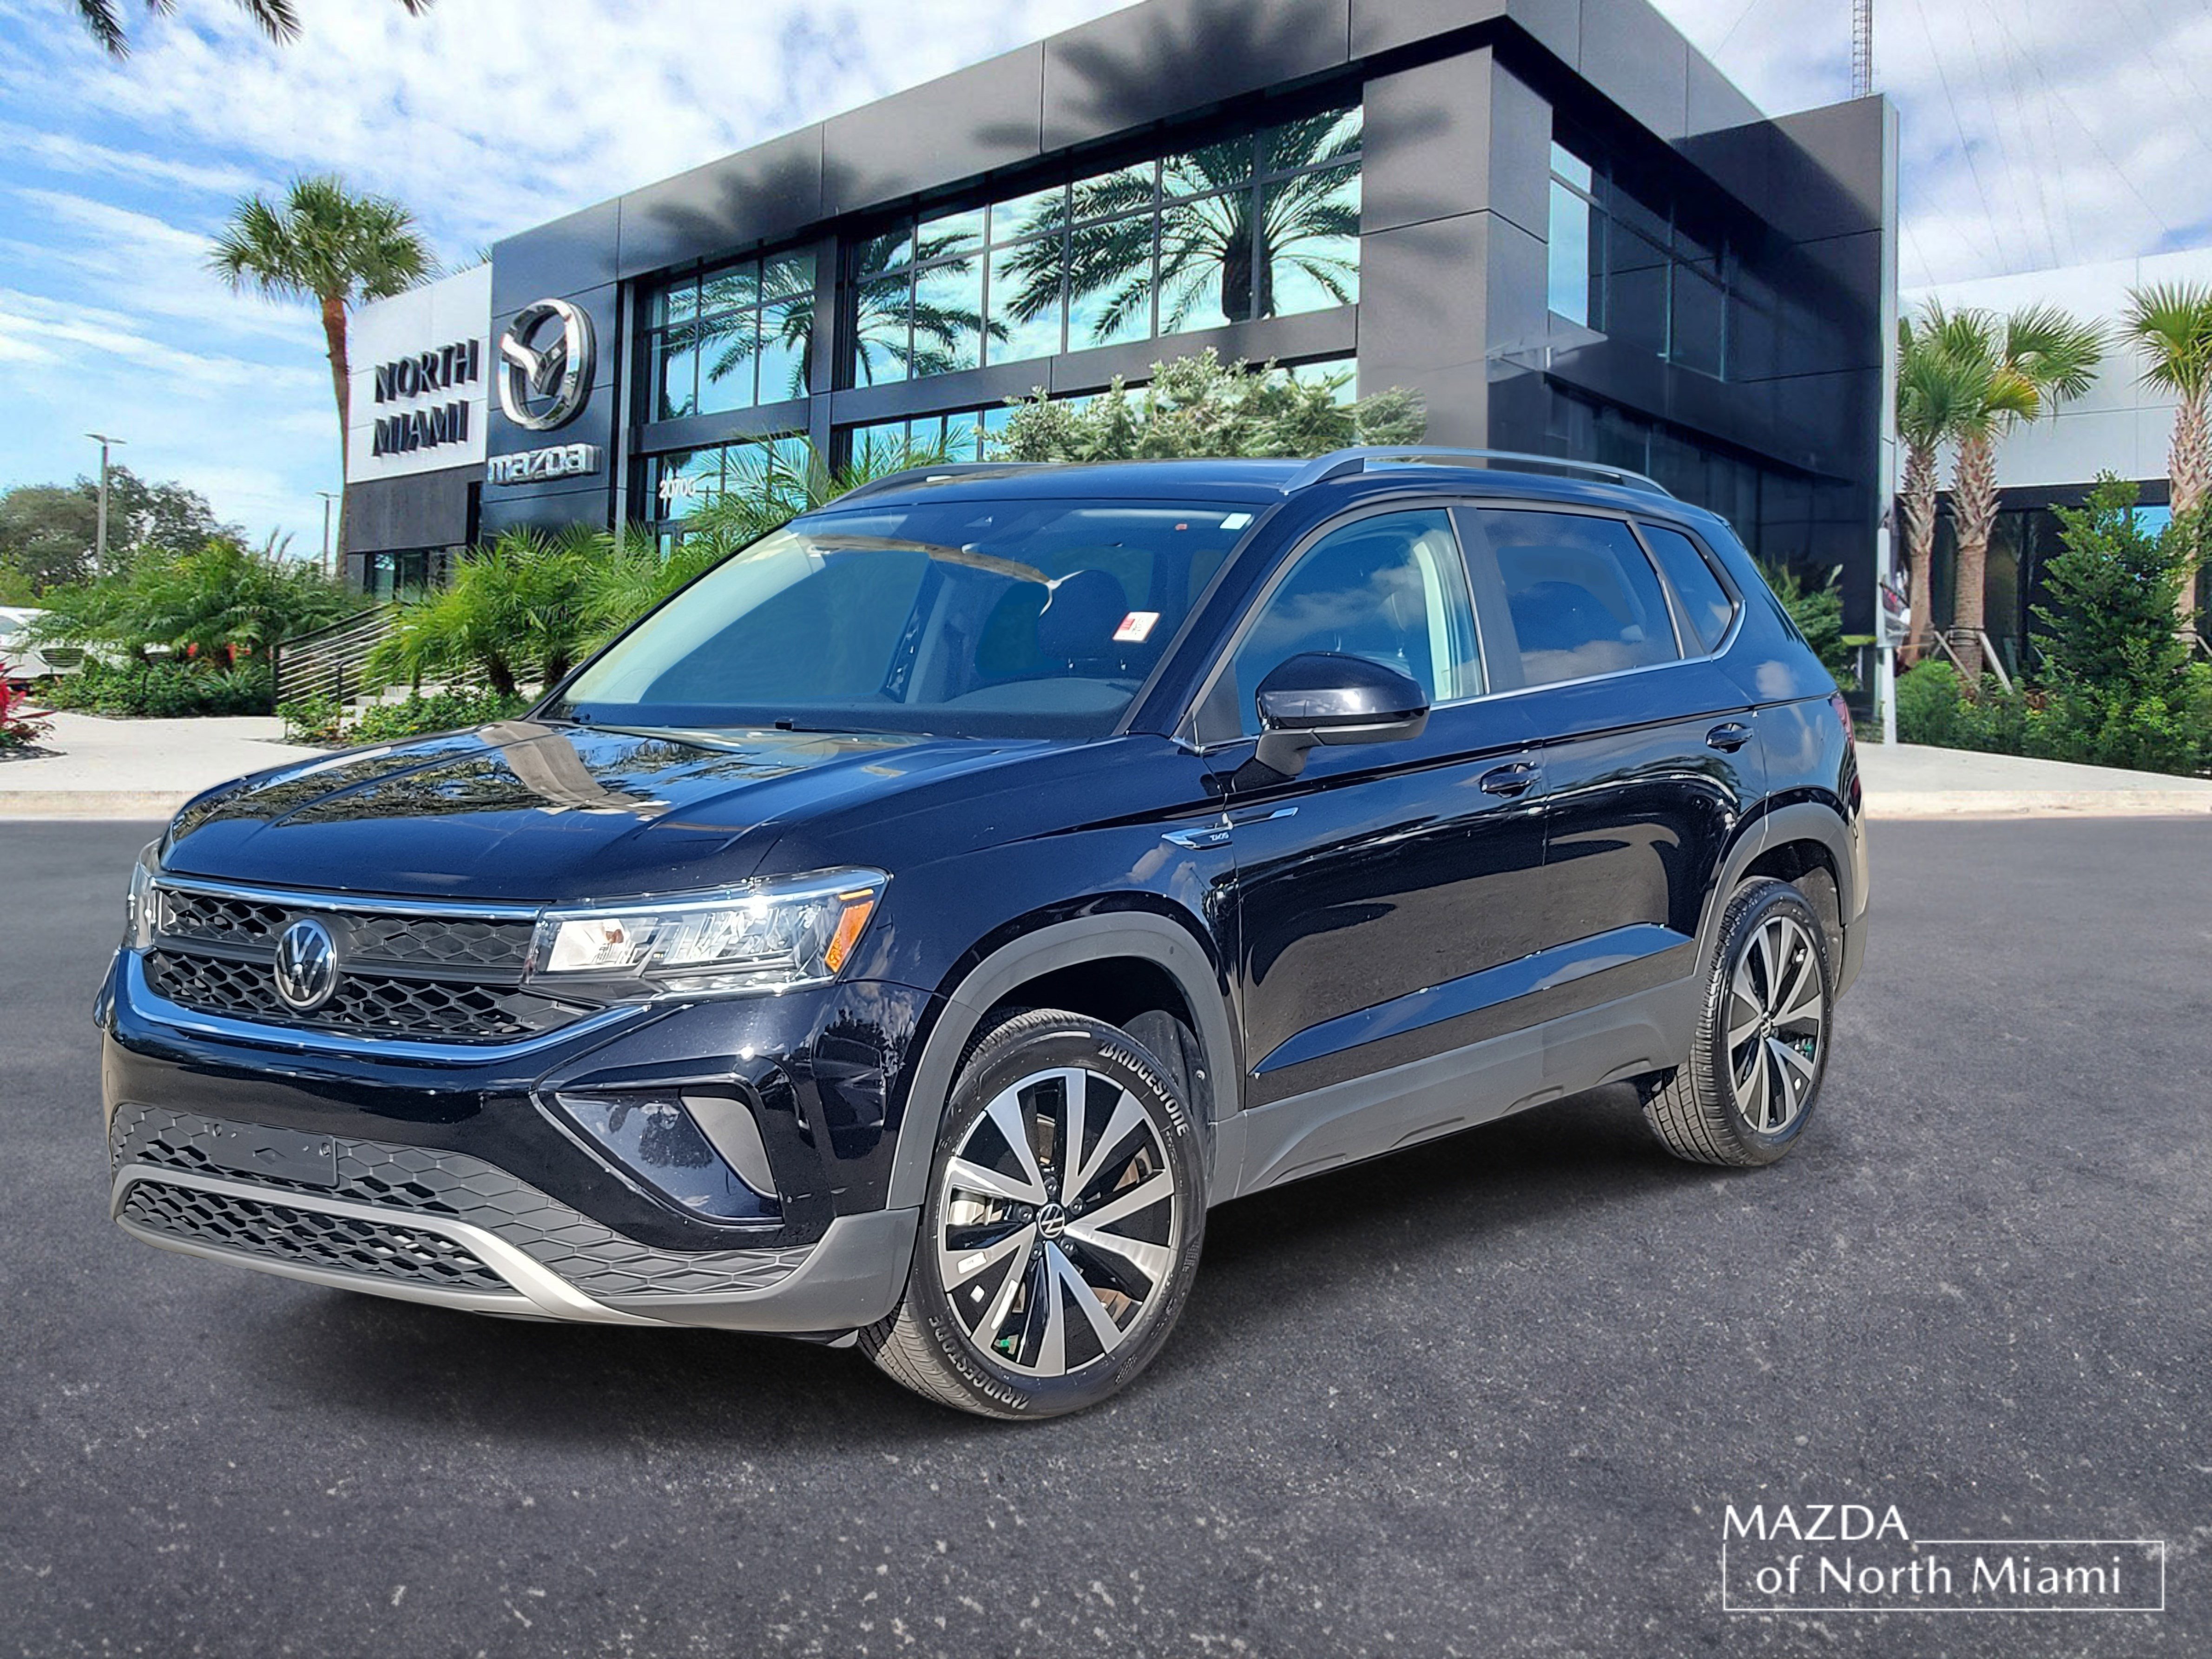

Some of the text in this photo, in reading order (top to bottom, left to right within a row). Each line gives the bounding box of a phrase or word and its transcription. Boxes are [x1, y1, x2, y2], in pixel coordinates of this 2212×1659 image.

[375, 338, 479, 404] NORTH
[372, 400, 470, 457] MIAMI
[1098, 1042, 1190, 1137] BRIDGESTONE
